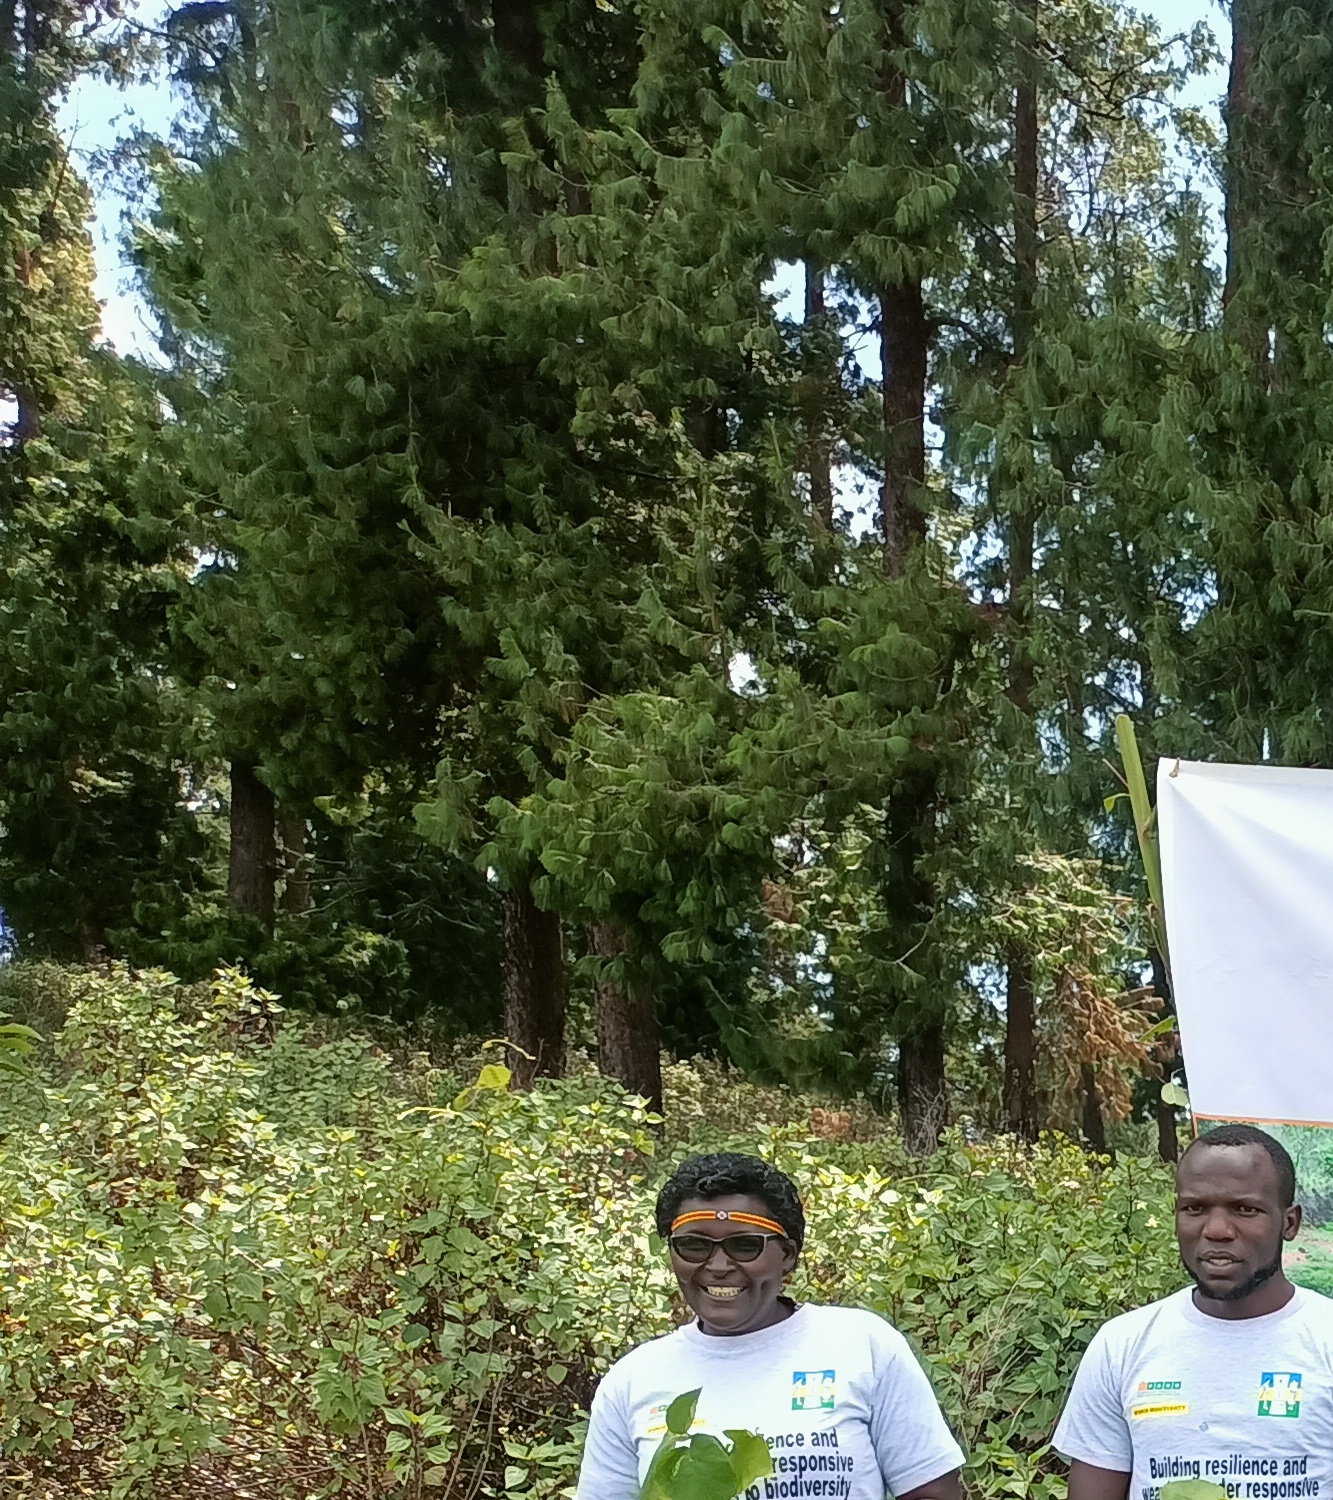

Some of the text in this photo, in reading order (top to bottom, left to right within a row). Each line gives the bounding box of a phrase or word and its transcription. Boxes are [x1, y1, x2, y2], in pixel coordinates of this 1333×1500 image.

[810, 1428, 839, 1448] and
[771, 1450, 854, 1479] responsive
[1150, 1454, 1308, 1480] Building resilience and
[1246, 1476, 1320, 1500] responsive
